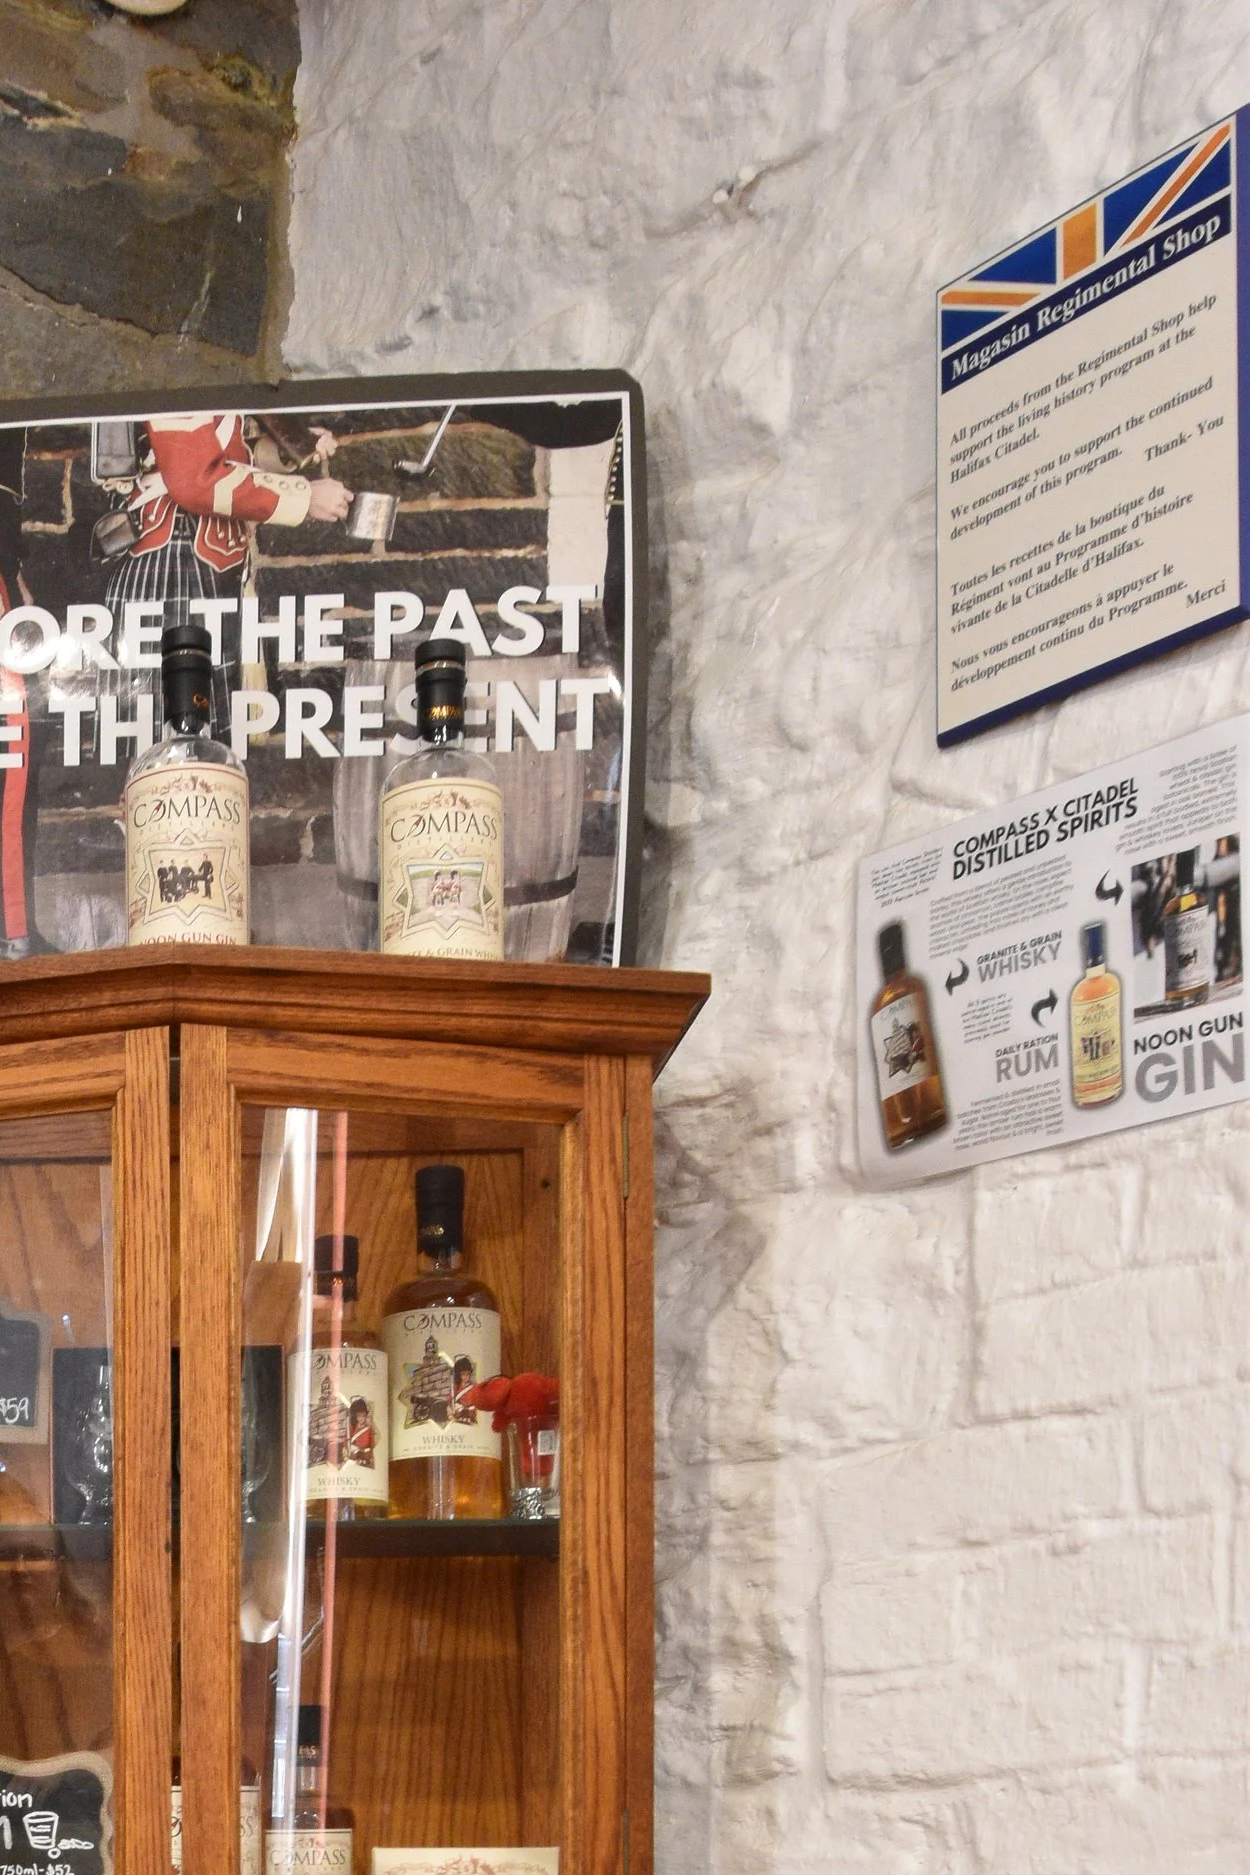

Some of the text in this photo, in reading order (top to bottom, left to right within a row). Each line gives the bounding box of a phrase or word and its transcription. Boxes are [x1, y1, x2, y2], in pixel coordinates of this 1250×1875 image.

[951, 215, 1221, 380] Magasin Regimental Shop
[950, 295, 1216, 446] All proceeds from the Regimental Shop help
[950, 327, 1195, 464] support the living history program at the
[950, 376, 1212, 520] We encourage you to support the continued
[950, 427, 1040, 484] Halifax Citadel.
[1197, 415, 1223, 436] You
[950, 448, 1122, 540] development of this program.
[950, 485, 1164, 596] Toutes les recettes de la boutique du
[951, 581, 1004, 616] Régiment
[1008, 567, 1033, 587] vont
[1036, 561, 1051, 575] au
[1055, 524, 1127, 566] Programme
[190, 593, 344, 665] THE
[374, 584, 597, 660] PAST
[951, 609, 991, 634] vivante
[994, 600, 1008, 614] de
[1011, 593, 1021, 606] la
[1025, 566, 1078, 599] Citadelle
[951, 563, 1174, 673] Nous vous encourageons à appuyer le
[1186, 579, 1225, 608] Merci
[951, 581, 1188, 691] développement continu du Programme.
[51, 692, 154, 767] TH
[134, 795, 241, 829] COMPASS
[390, 812, 498, 843] COMPASS
[953, 812, 1040, 859] COMPASS
[1044, 804, 1059, 826] X
[1063, 777, 1139, 817] CITADEL
[953, 829, 1050, 880] DISTILLED
[1055, 797, 1137, 843] SPIRITS
[181, 931, 212, 944] GUN
[977, 945, 1019, 965] GRANITE
[1020, 941, 1027, 951] &
[1029, 930, 1062, 949] GRAIN
[978, 941, 1061, 983] WHISKY
[995, 1032, 1058, 1058] DAILY RATION
[996, 1043, 1059, 1084] RUM
[1134, 1011, 1243, 1055] NOON GUN
[1135, 1032, 1245, 1104] GIN
[404, 1312, 482, 1331] COMPASS
[422, 1434, 466, 1445] WHISKY
